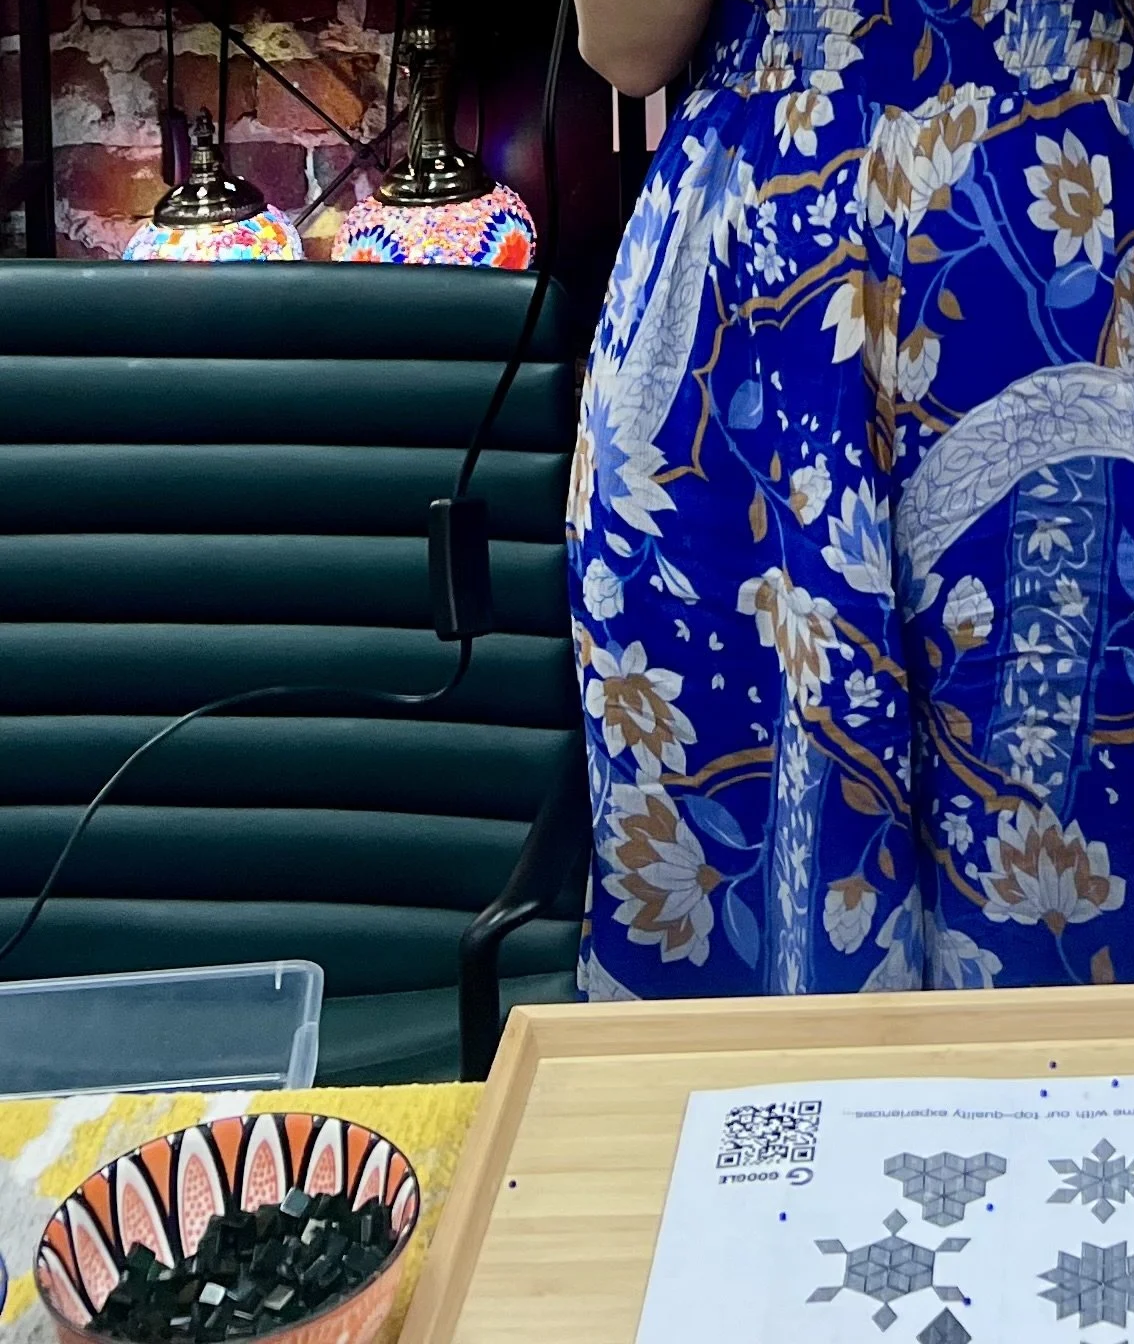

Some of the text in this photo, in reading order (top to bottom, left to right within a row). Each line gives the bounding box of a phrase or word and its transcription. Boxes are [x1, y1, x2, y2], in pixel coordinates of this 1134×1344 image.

[1045, 1109, 1070, 1119] our
[1076, 1109, 1108, 1119] with
[718, 1170, 780, 1185] GOOGLE
